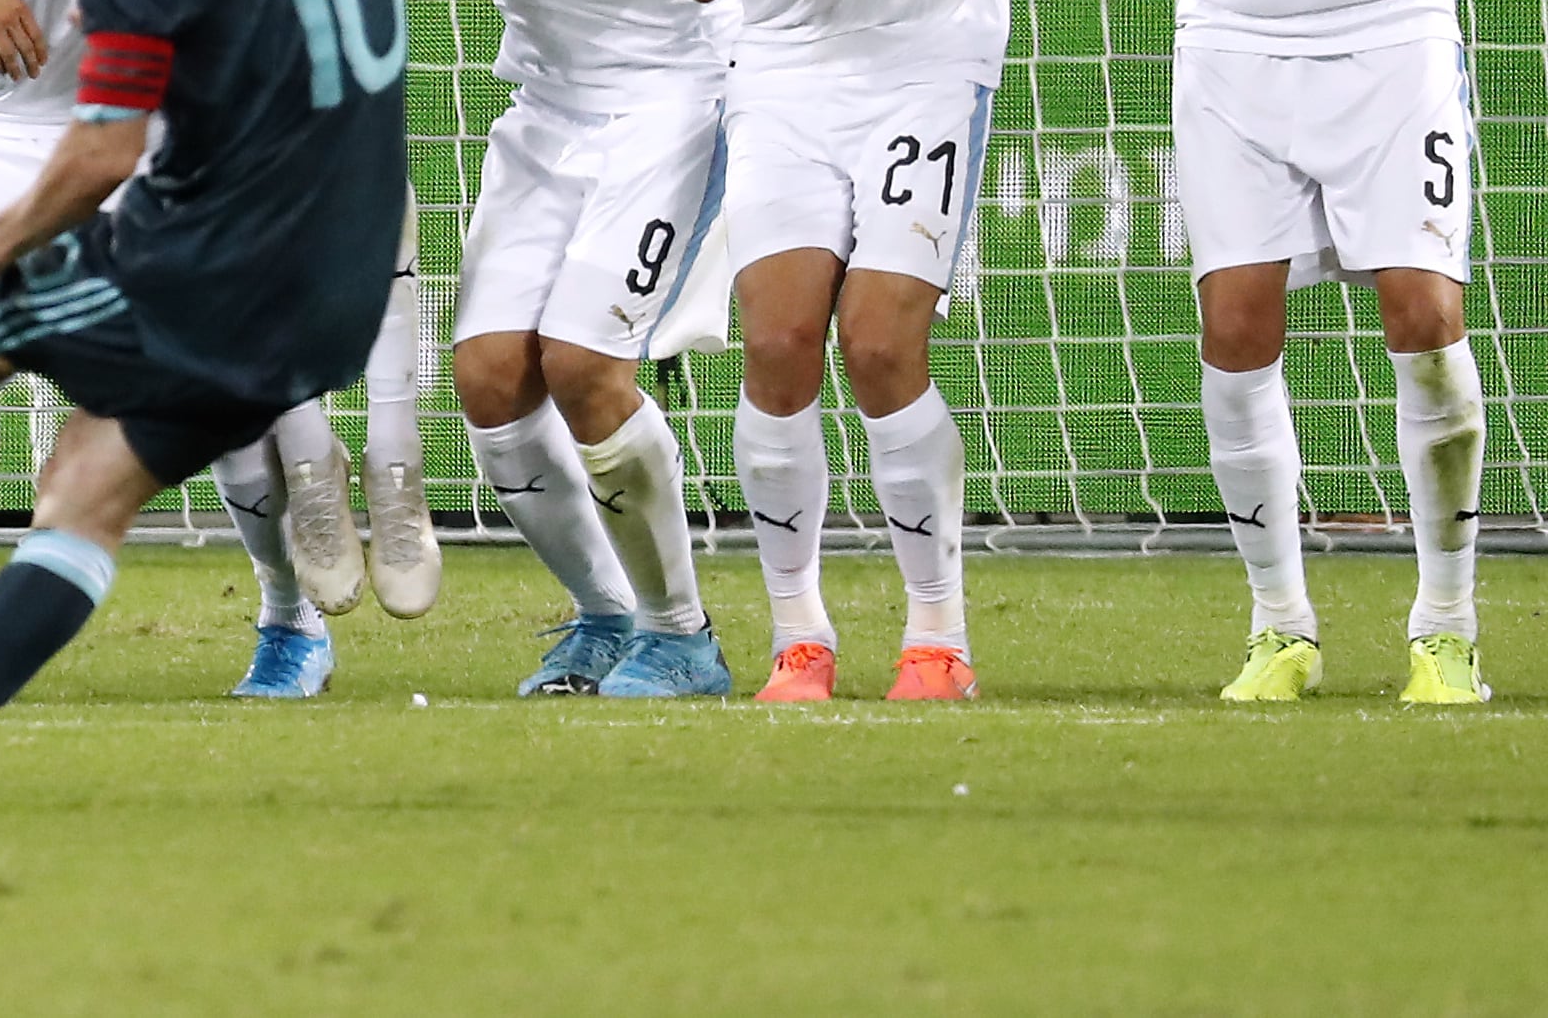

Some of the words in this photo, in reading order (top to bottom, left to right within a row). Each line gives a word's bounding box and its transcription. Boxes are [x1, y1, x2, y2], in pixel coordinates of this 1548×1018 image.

[881, 135, 956, 216] 21
[1424, 130, 1454, 208] 5
[625, 218, 676, 297] 9
